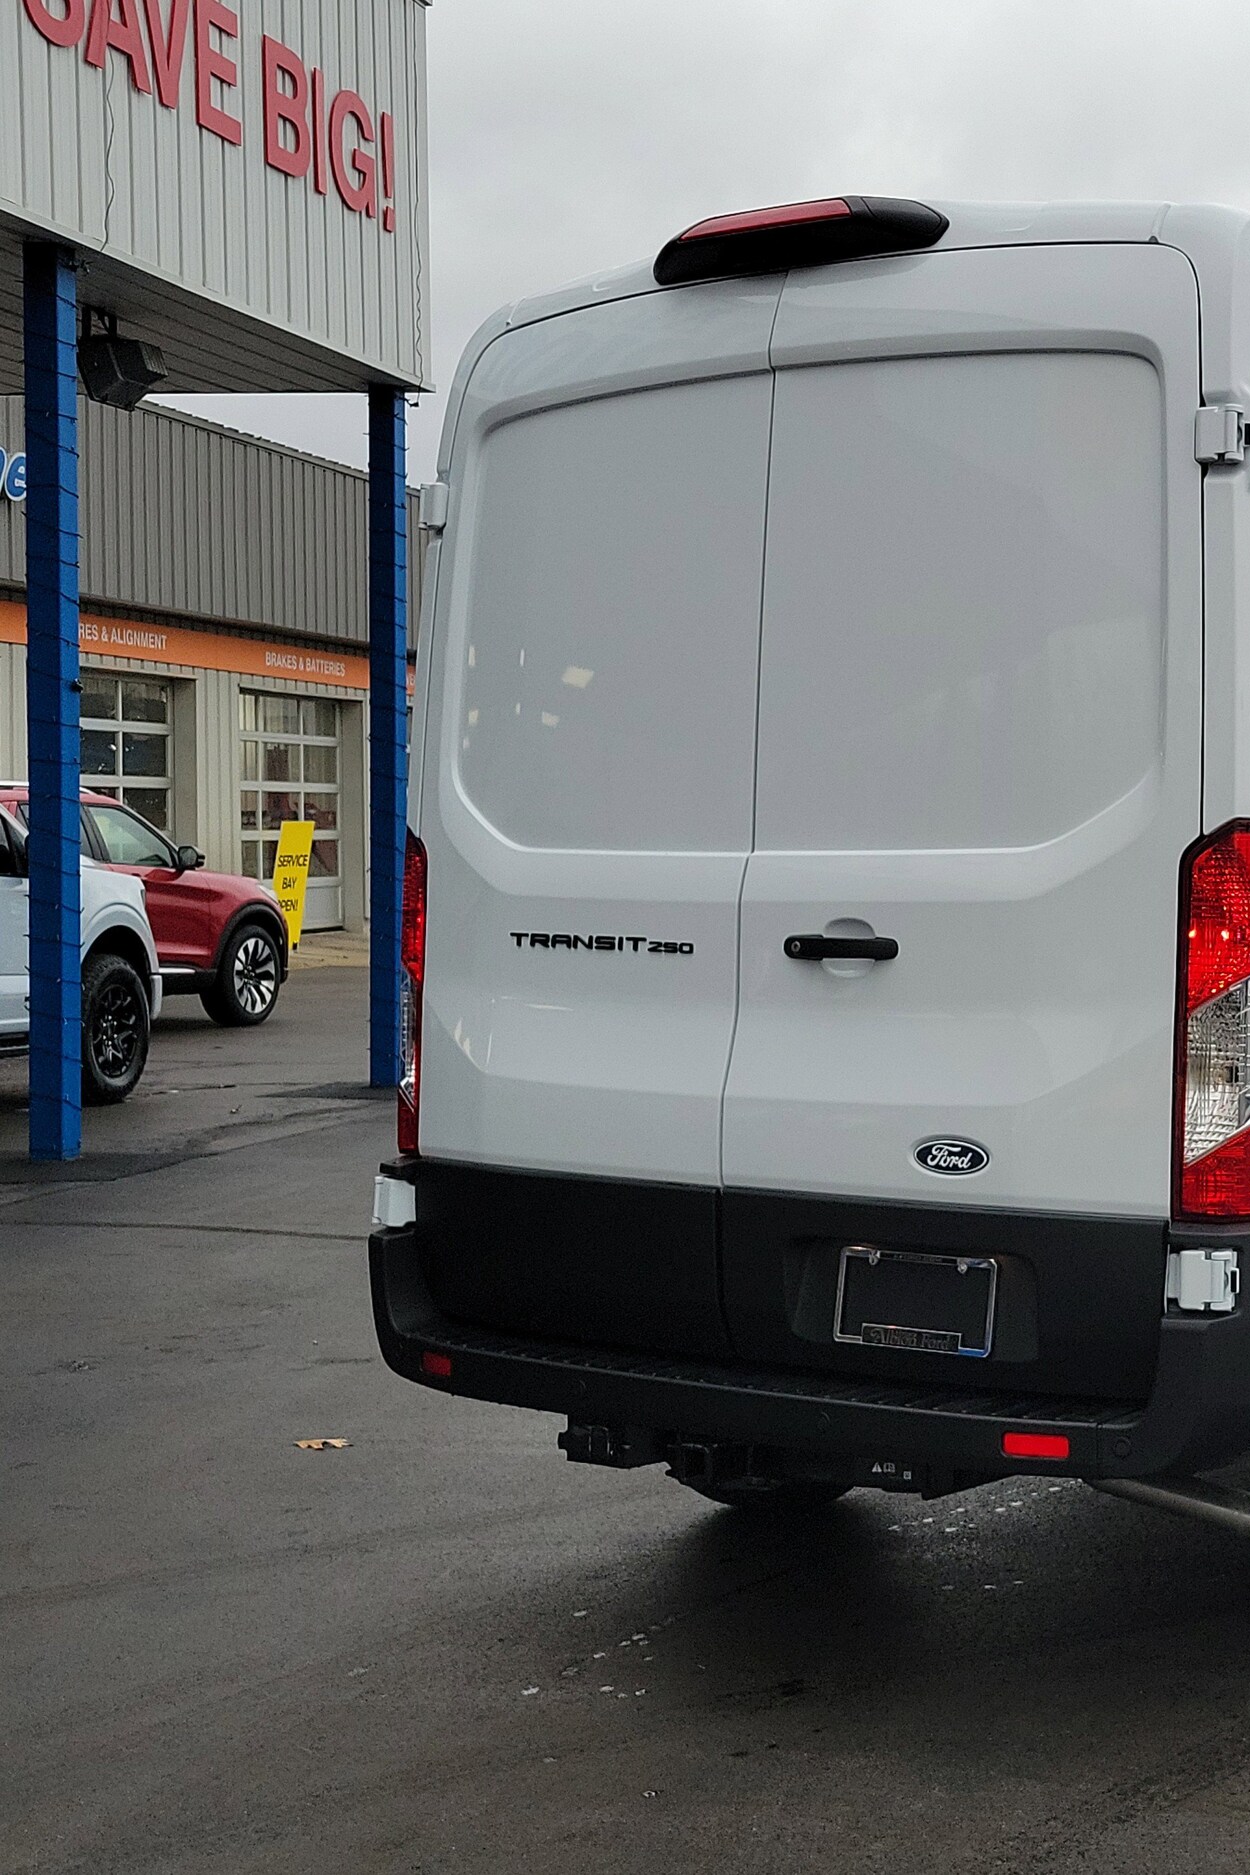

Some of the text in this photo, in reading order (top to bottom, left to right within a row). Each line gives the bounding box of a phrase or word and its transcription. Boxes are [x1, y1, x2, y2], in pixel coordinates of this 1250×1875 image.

[262, 34, 395, 233] BIG!
[78, 622, 167, 650] RES & ALIGNMENT
[265, 651, 346, 677] BRAKES & BATTERIES
[277, 854, 308, 868] SERVICE
[281, 877, 298, 890] BAY
[510, 932, 694, 954] TRANSIT 250
[927, 1144, 973, 1169] Ford
[920, 1333, 950, 1350] Ford
